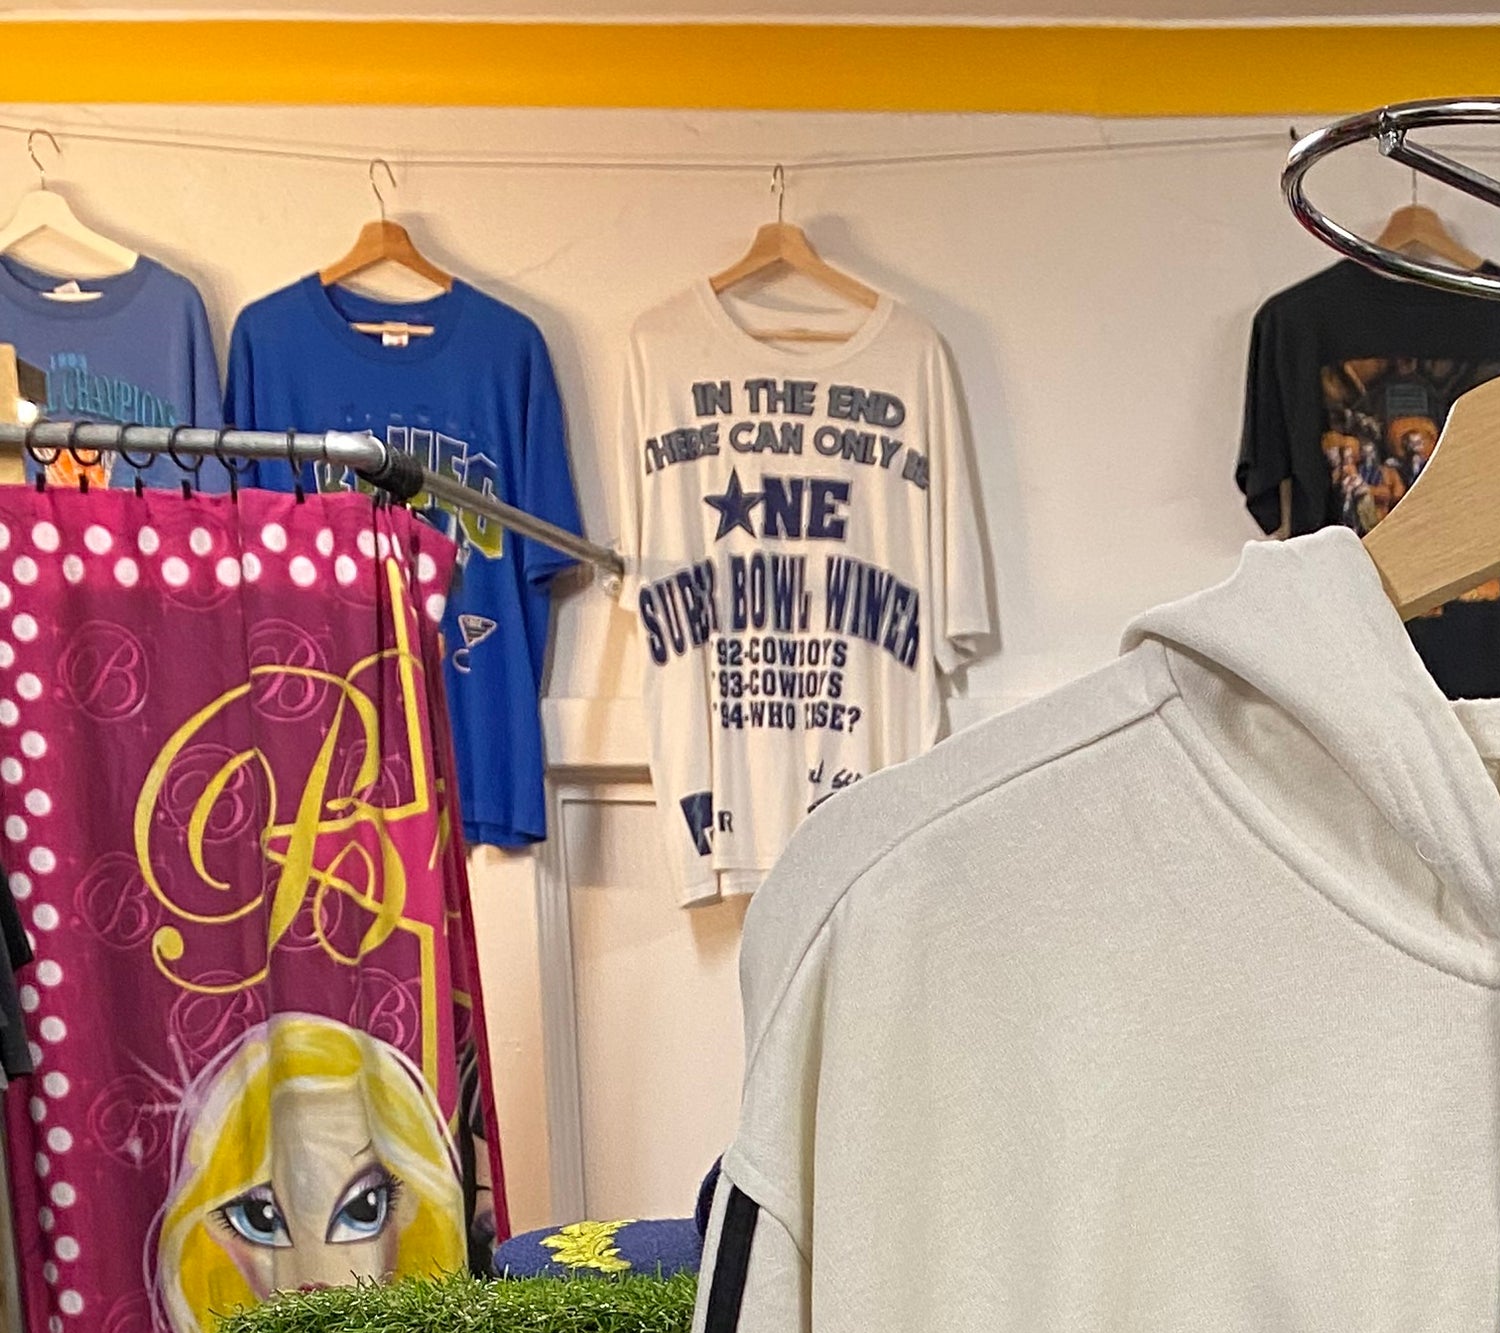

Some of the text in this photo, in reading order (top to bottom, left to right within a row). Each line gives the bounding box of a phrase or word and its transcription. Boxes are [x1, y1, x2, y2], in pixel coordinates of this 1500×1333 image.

[691, 378, 906, 429] IN THE END
[728, 420, 804, 455] CAN
[813, 425, 903, 470] ONLY
[731, 550, 812, 634] BOWL
